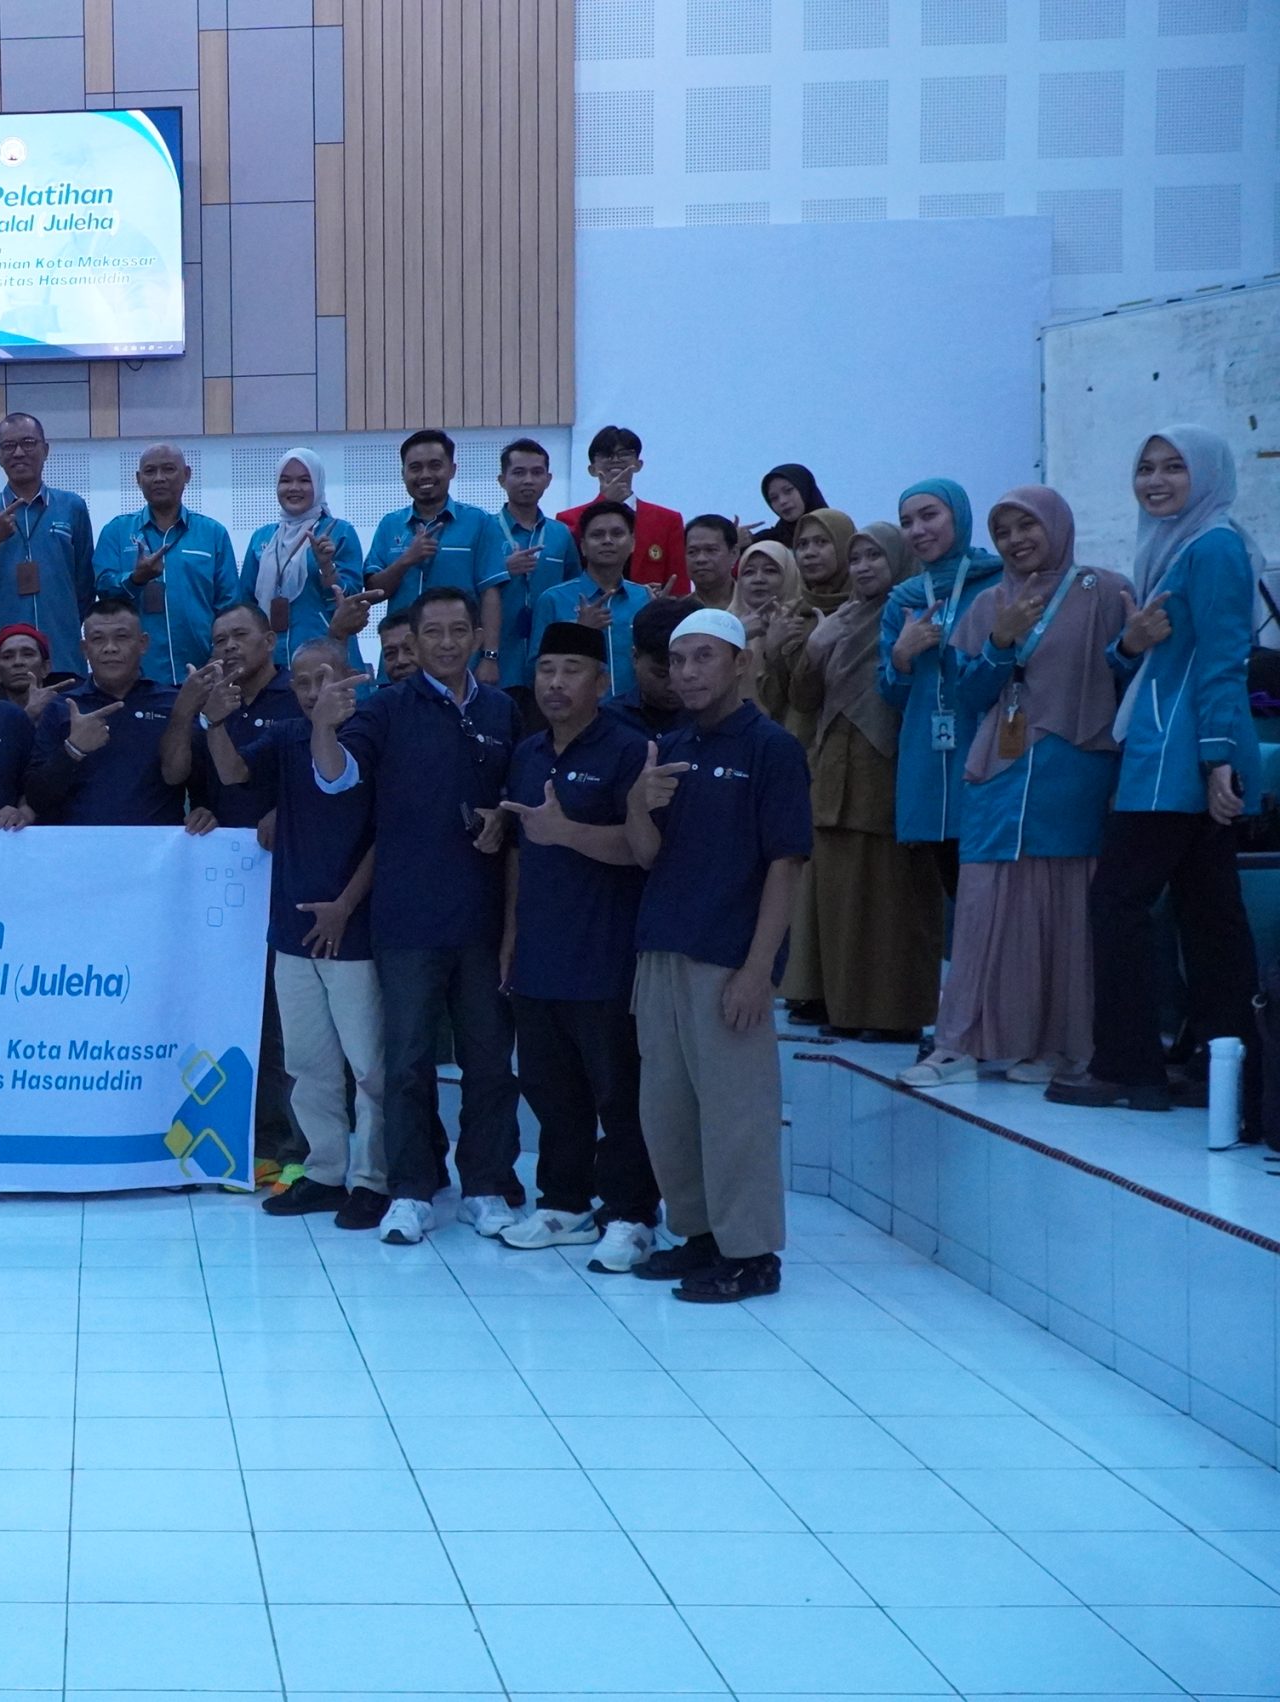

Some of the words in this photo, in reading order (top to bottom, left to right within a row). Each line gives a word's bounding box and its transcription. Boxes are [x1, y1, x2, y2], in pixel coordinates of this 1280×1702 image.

[35, 257, 73, 269] Kota
[78, 255, 157, 268] Makassar
[39, 273, 131, 285] Hasanuddin
[14, 964, 130, 1004] (Juleha)
[7, 1039, 61, 1060] Kota
[68, 1040, 178, 1061] Makassar
[11, 1069, 142, 1091] Hasanuddin
